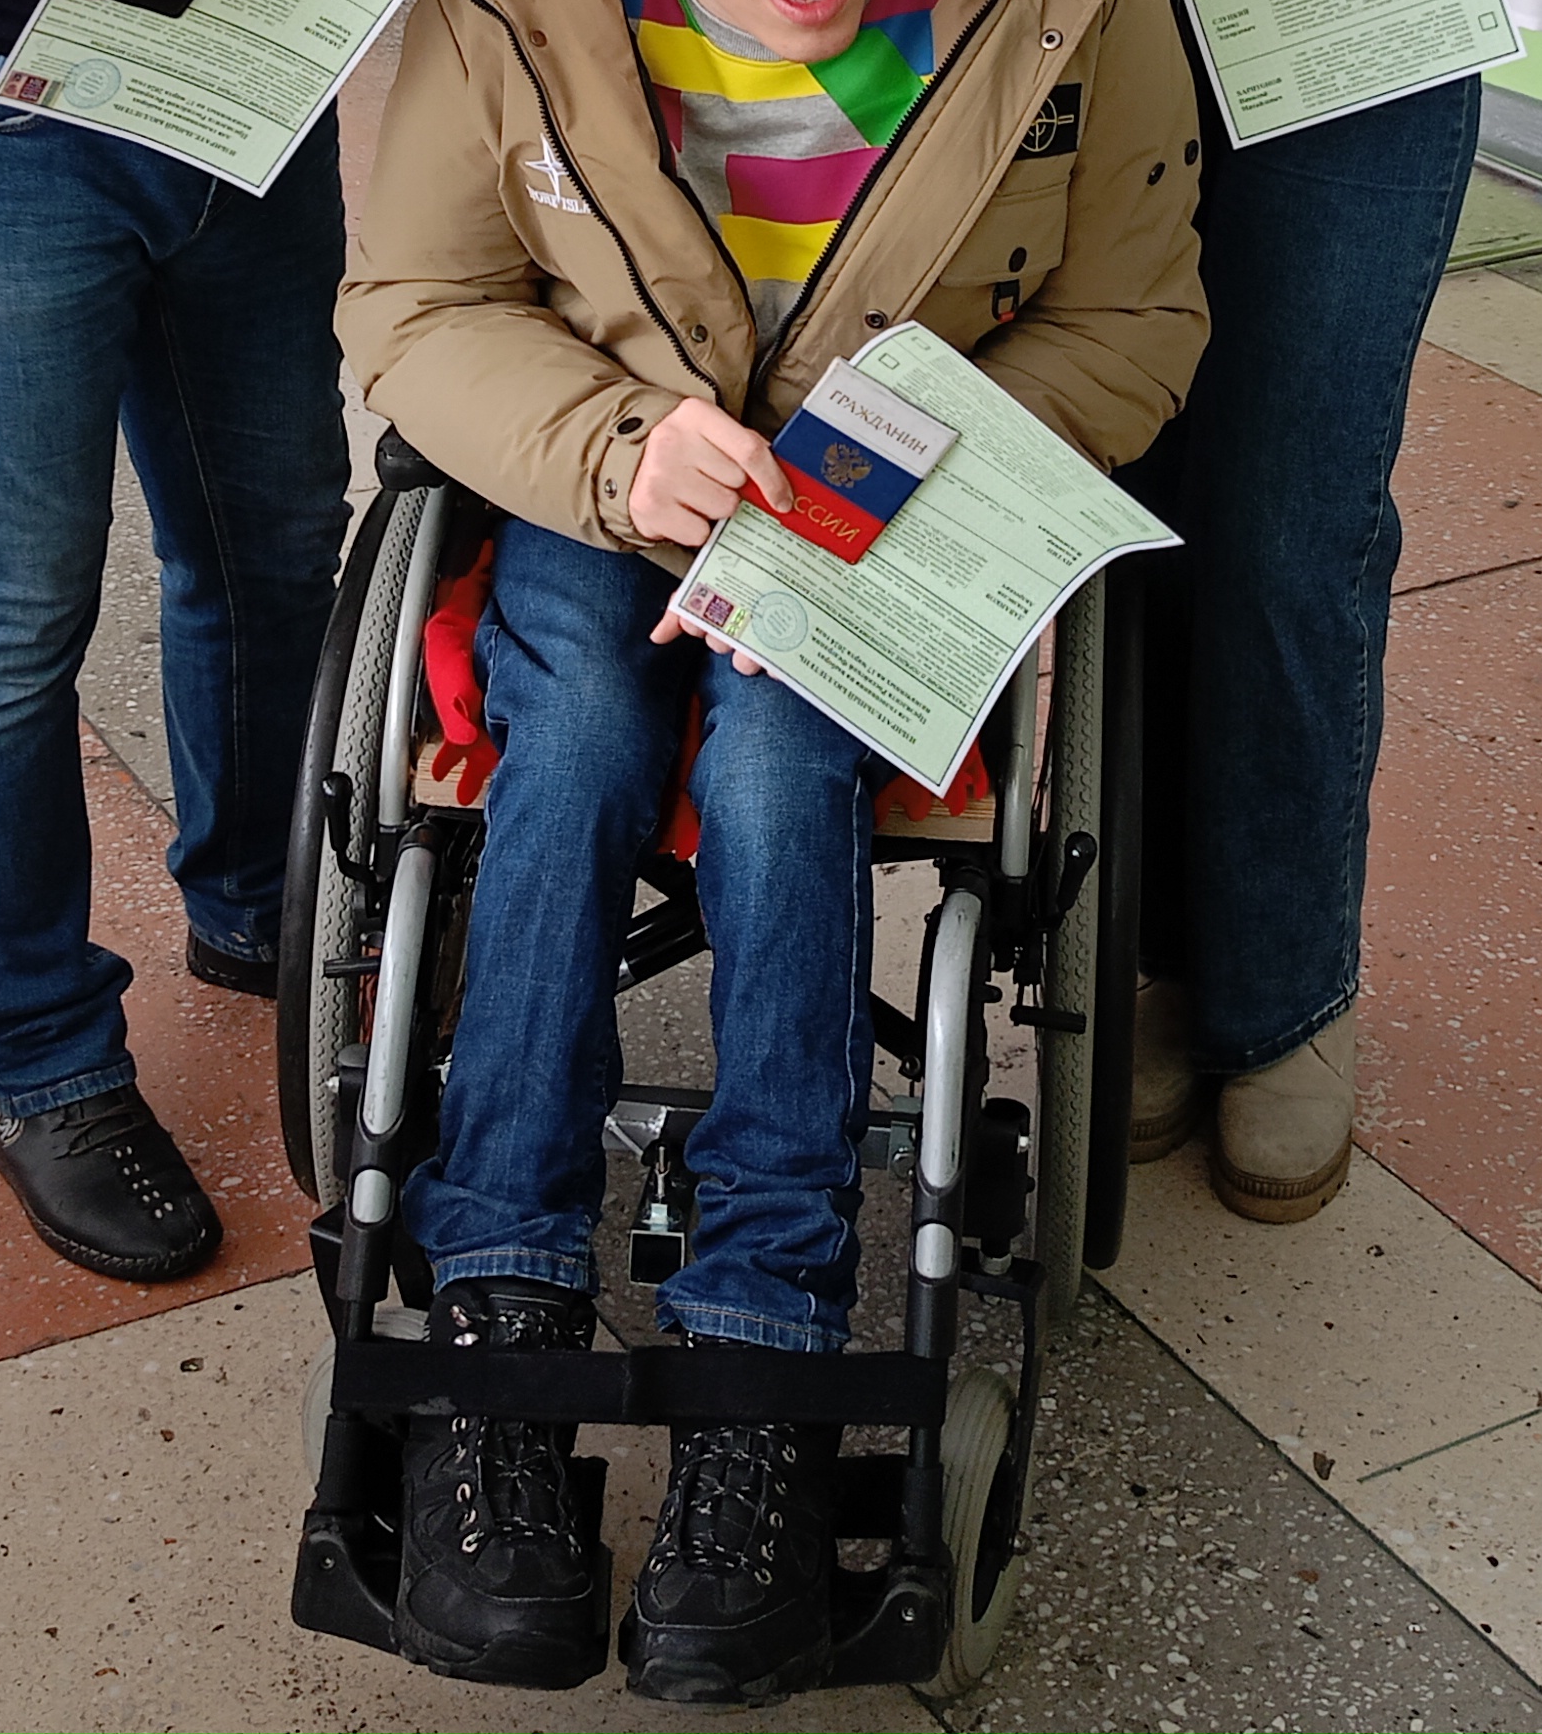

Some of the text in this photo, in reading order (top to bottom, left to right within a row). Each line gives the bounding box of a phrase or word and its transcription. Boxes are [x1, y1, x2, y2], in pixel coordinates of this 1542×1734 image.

[561, 197, 592, 215] ISLA
[829, 389, 928, 456] ГРАЖДАНИН
[793, 495, 860, 544] ССИИ
